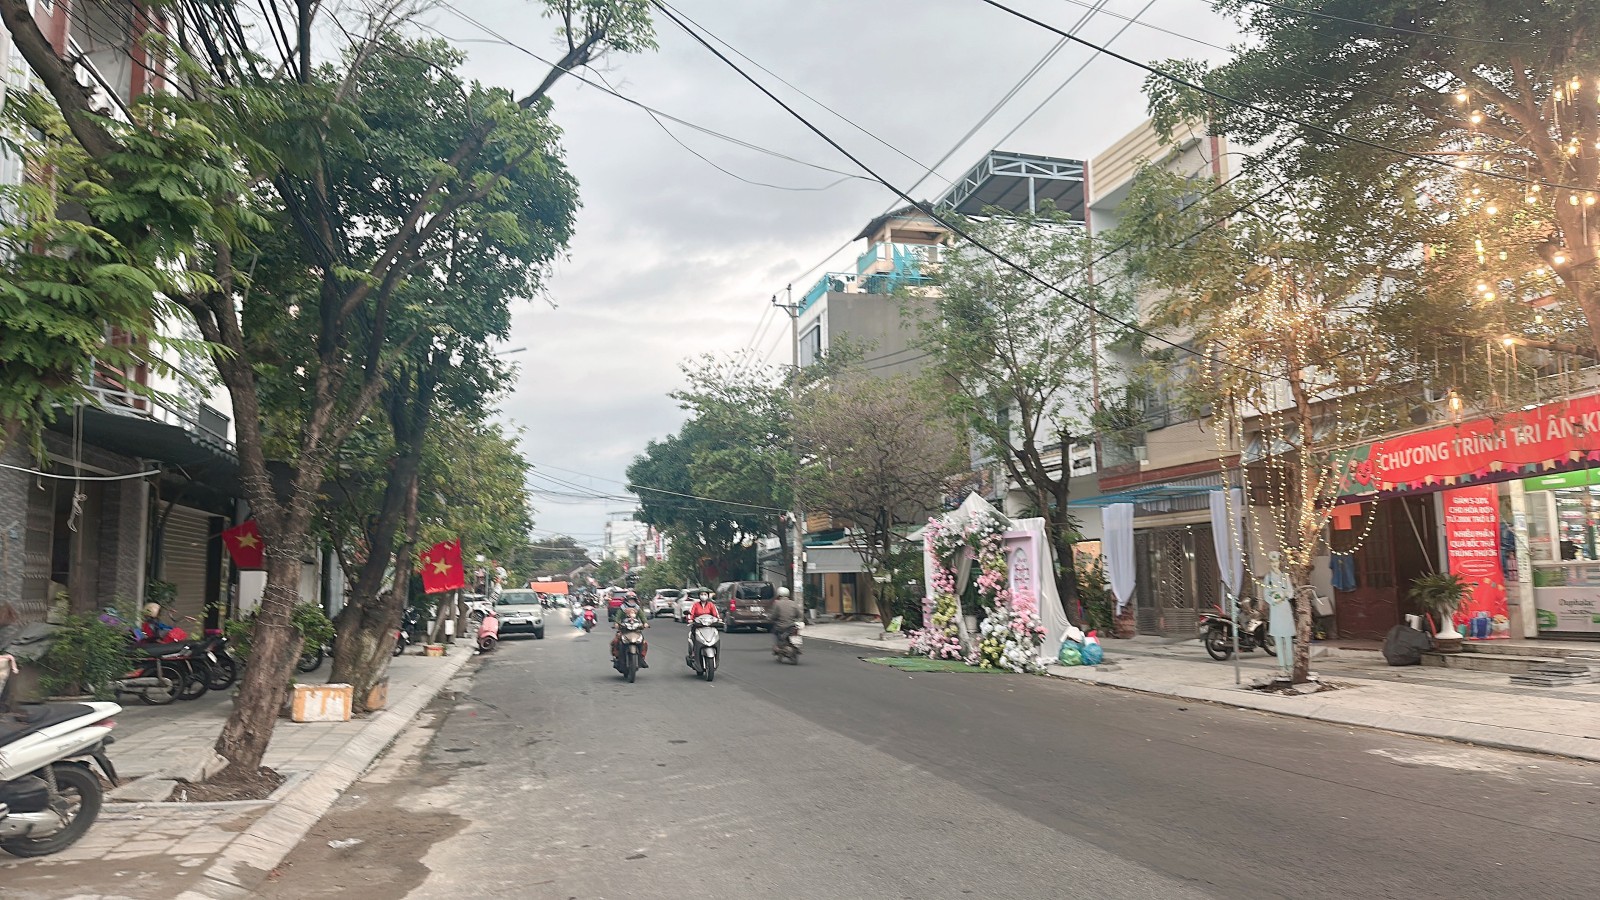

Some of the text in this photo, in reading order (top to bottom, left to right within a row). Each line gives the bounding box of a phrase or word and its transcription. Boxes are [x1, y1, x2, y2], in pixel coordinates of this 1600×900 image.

[1380, 442, 1450, 471] CHƯƠNG
[1452, 431, 1507, 457] TRÌNH
[1510, 423, 1541, 446] TRI
[1546, 414, 1576, 440] ÂN
[1453, 528, 1495, 537] NHIỀU PHẦN
[1450, 539, 1465, 548] QUÀ
[1480, 539, 1496, 547] THĂ
